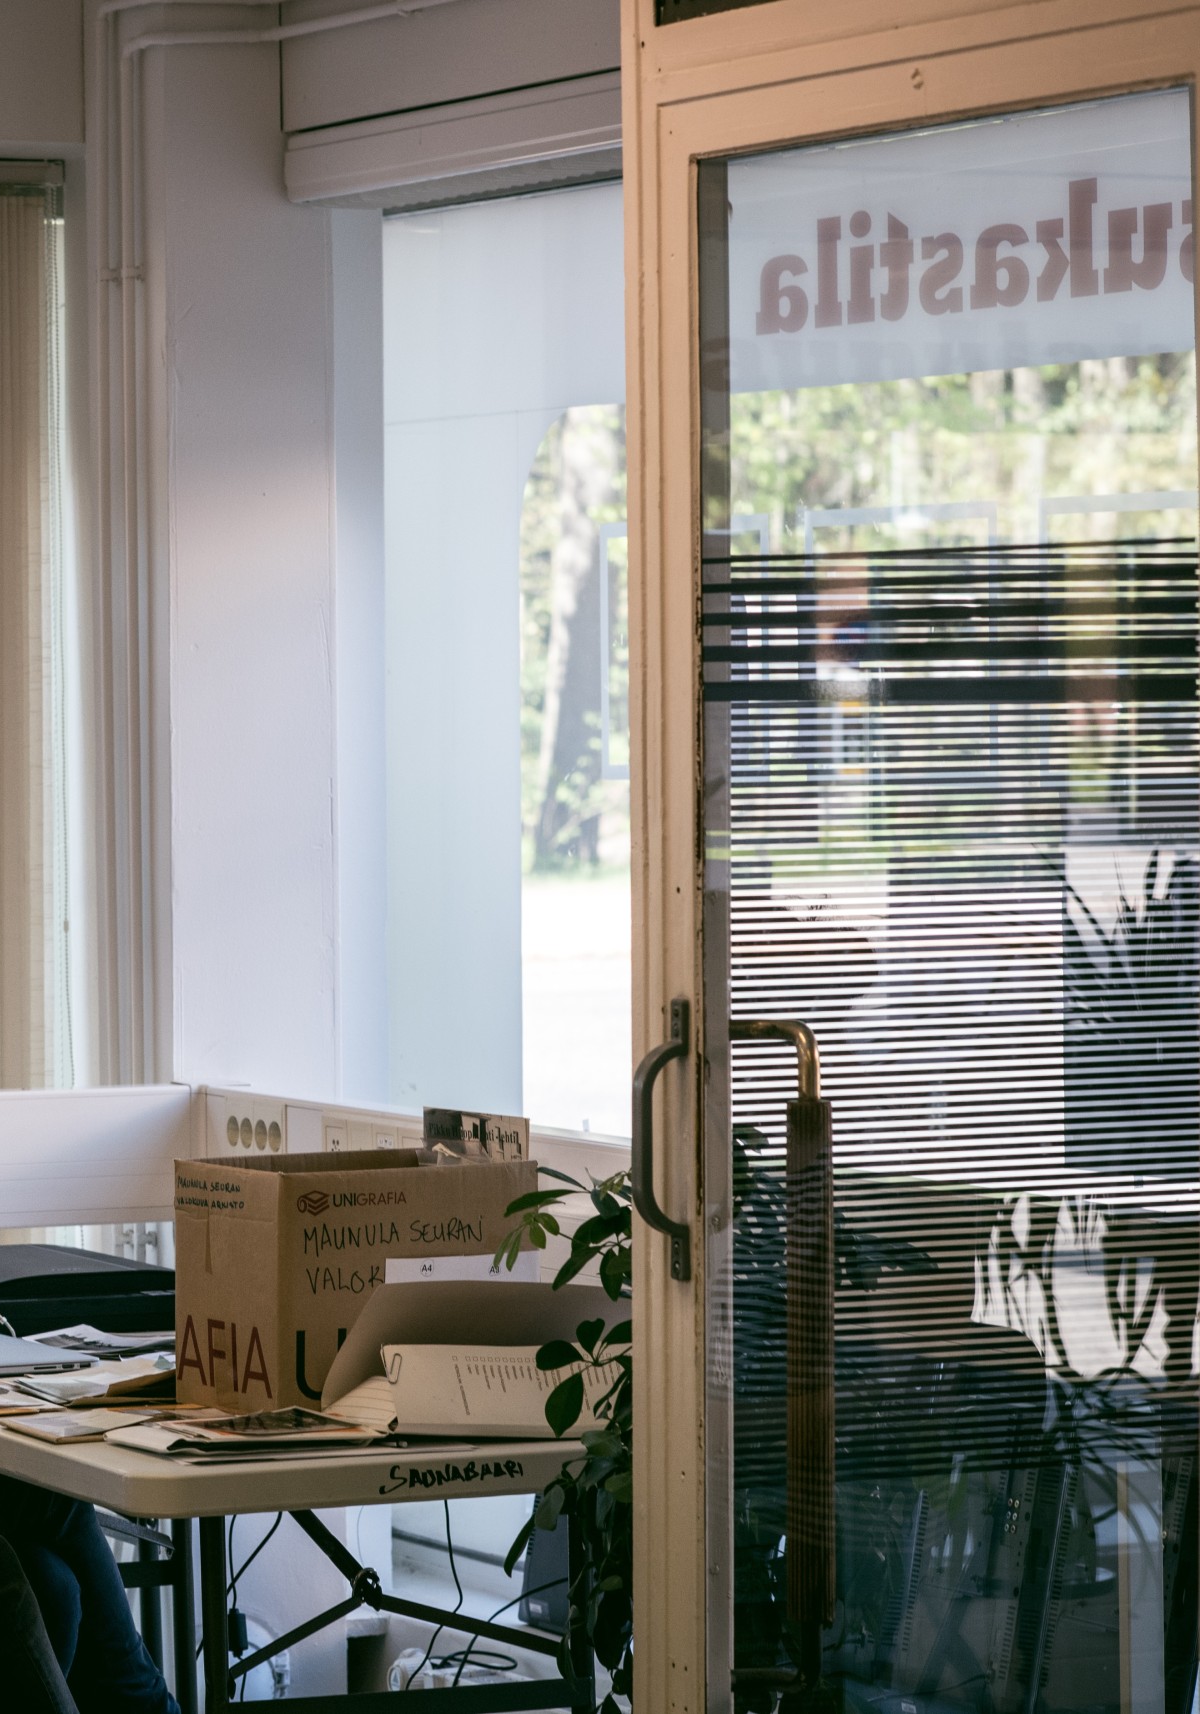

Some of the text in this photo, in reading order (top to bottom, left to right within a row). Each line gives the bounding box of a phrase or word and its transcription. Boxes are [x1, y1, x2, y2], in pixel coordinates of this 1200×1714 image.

[209, 1181, 241, 1194] SEURAN
[332, 1191, 407, 1208] UNIGRAFIA
[303, 1215, 485, 1257] MAUNULA SEURAN
[305, 1265, 384, 1295] VALOK
[421, 1264, 432, 1273] A4
[176, 1314, 273, 1400] AFIA
[378, 1460, 524, 1495] SAUNABAARI
